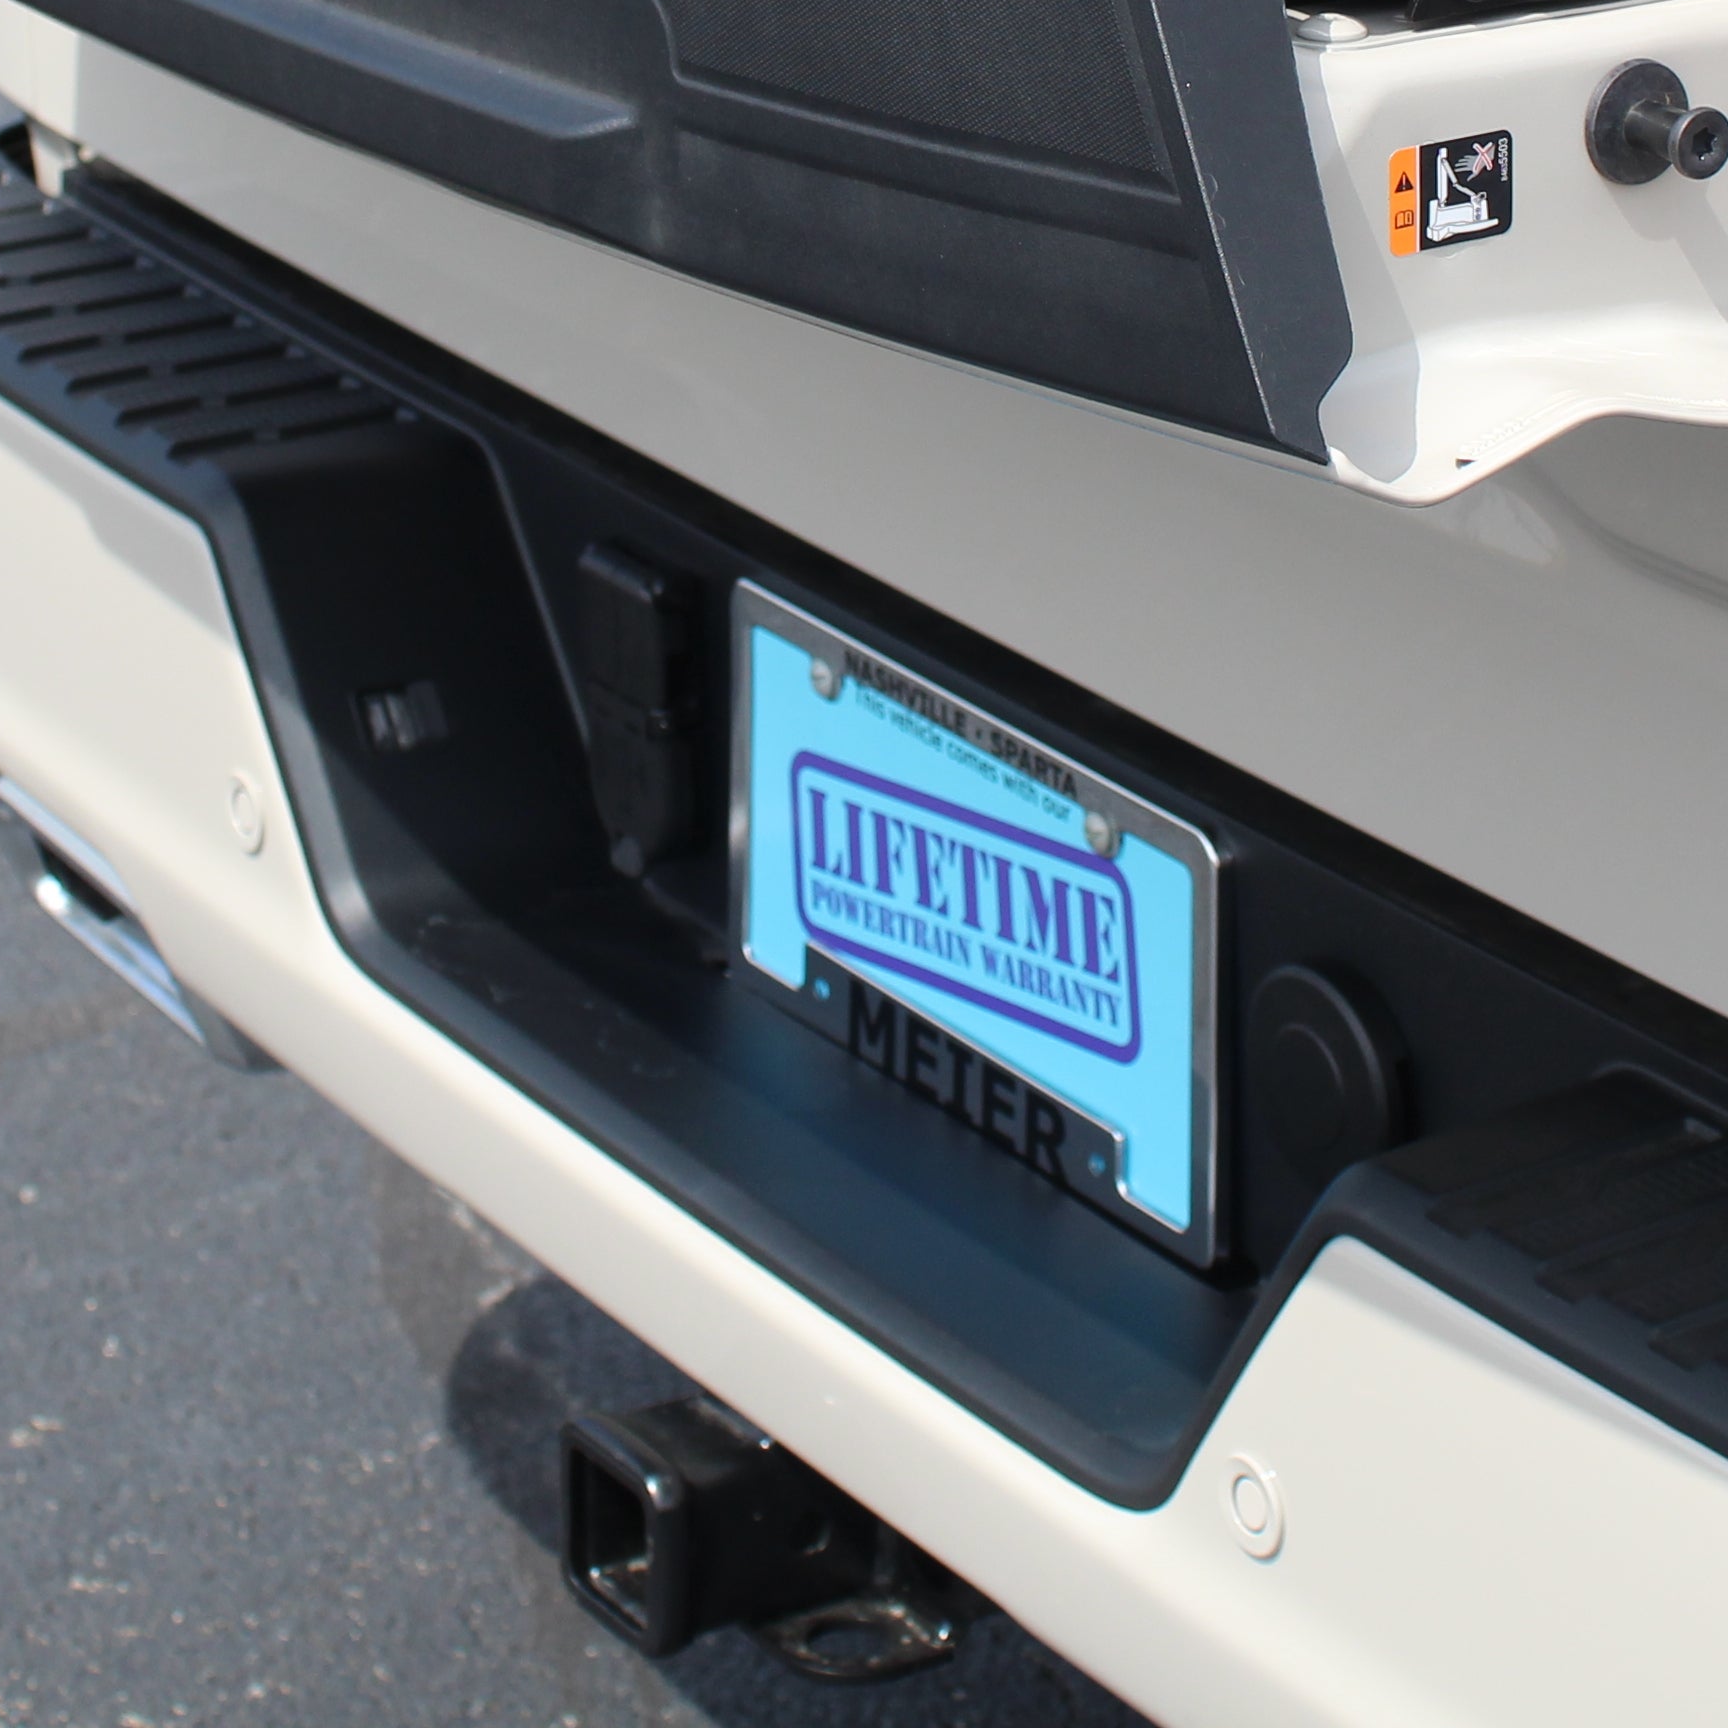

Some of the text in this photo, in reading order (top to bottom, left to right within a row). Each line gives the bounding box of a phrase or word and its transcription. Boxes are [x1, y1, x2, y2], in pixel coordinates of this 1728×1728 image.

[844, 649, 1078, 798] NASHVILLE SPARTA
[888, 709, 944, 753] vehicle
[945, 741, 1000, 785] comes
[1001, 773, 1041, 808] with
[1041, 794, 1071, 823] our
[809, 788, 1120, 984] LIFETIME
[810, 878, 1122, 1029] POWERTRAIN WARRANTY
[847, 978, 1070, 1189] MEIER
